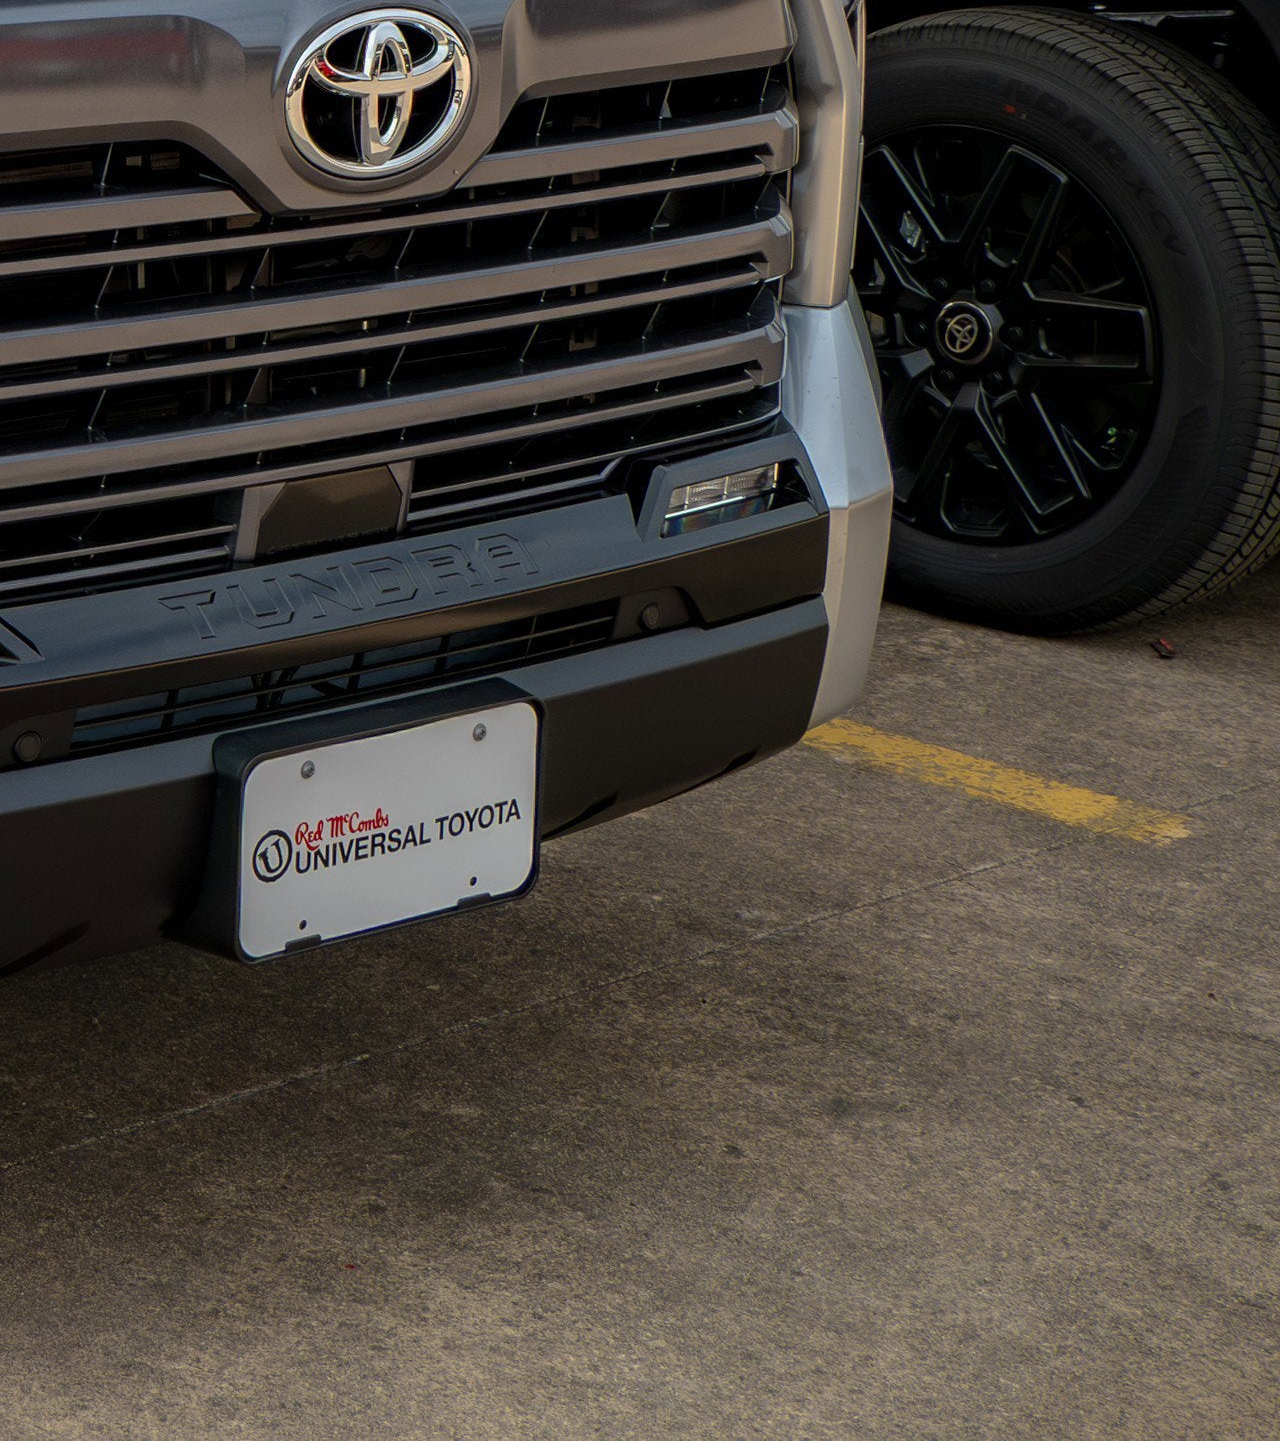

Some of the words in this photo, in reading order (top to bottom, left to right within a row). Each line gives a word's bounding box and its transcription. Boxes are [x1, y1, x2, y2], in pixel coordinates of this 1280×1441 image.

[156, 533, 539, 640] TUNDRA
[295, 819, 324, 852] Red
[327, 808, 390, 839] McCombs
[295, 822, 432, 874] UNIVERSAL
[435, 798, 522, 840] TOYOTA
